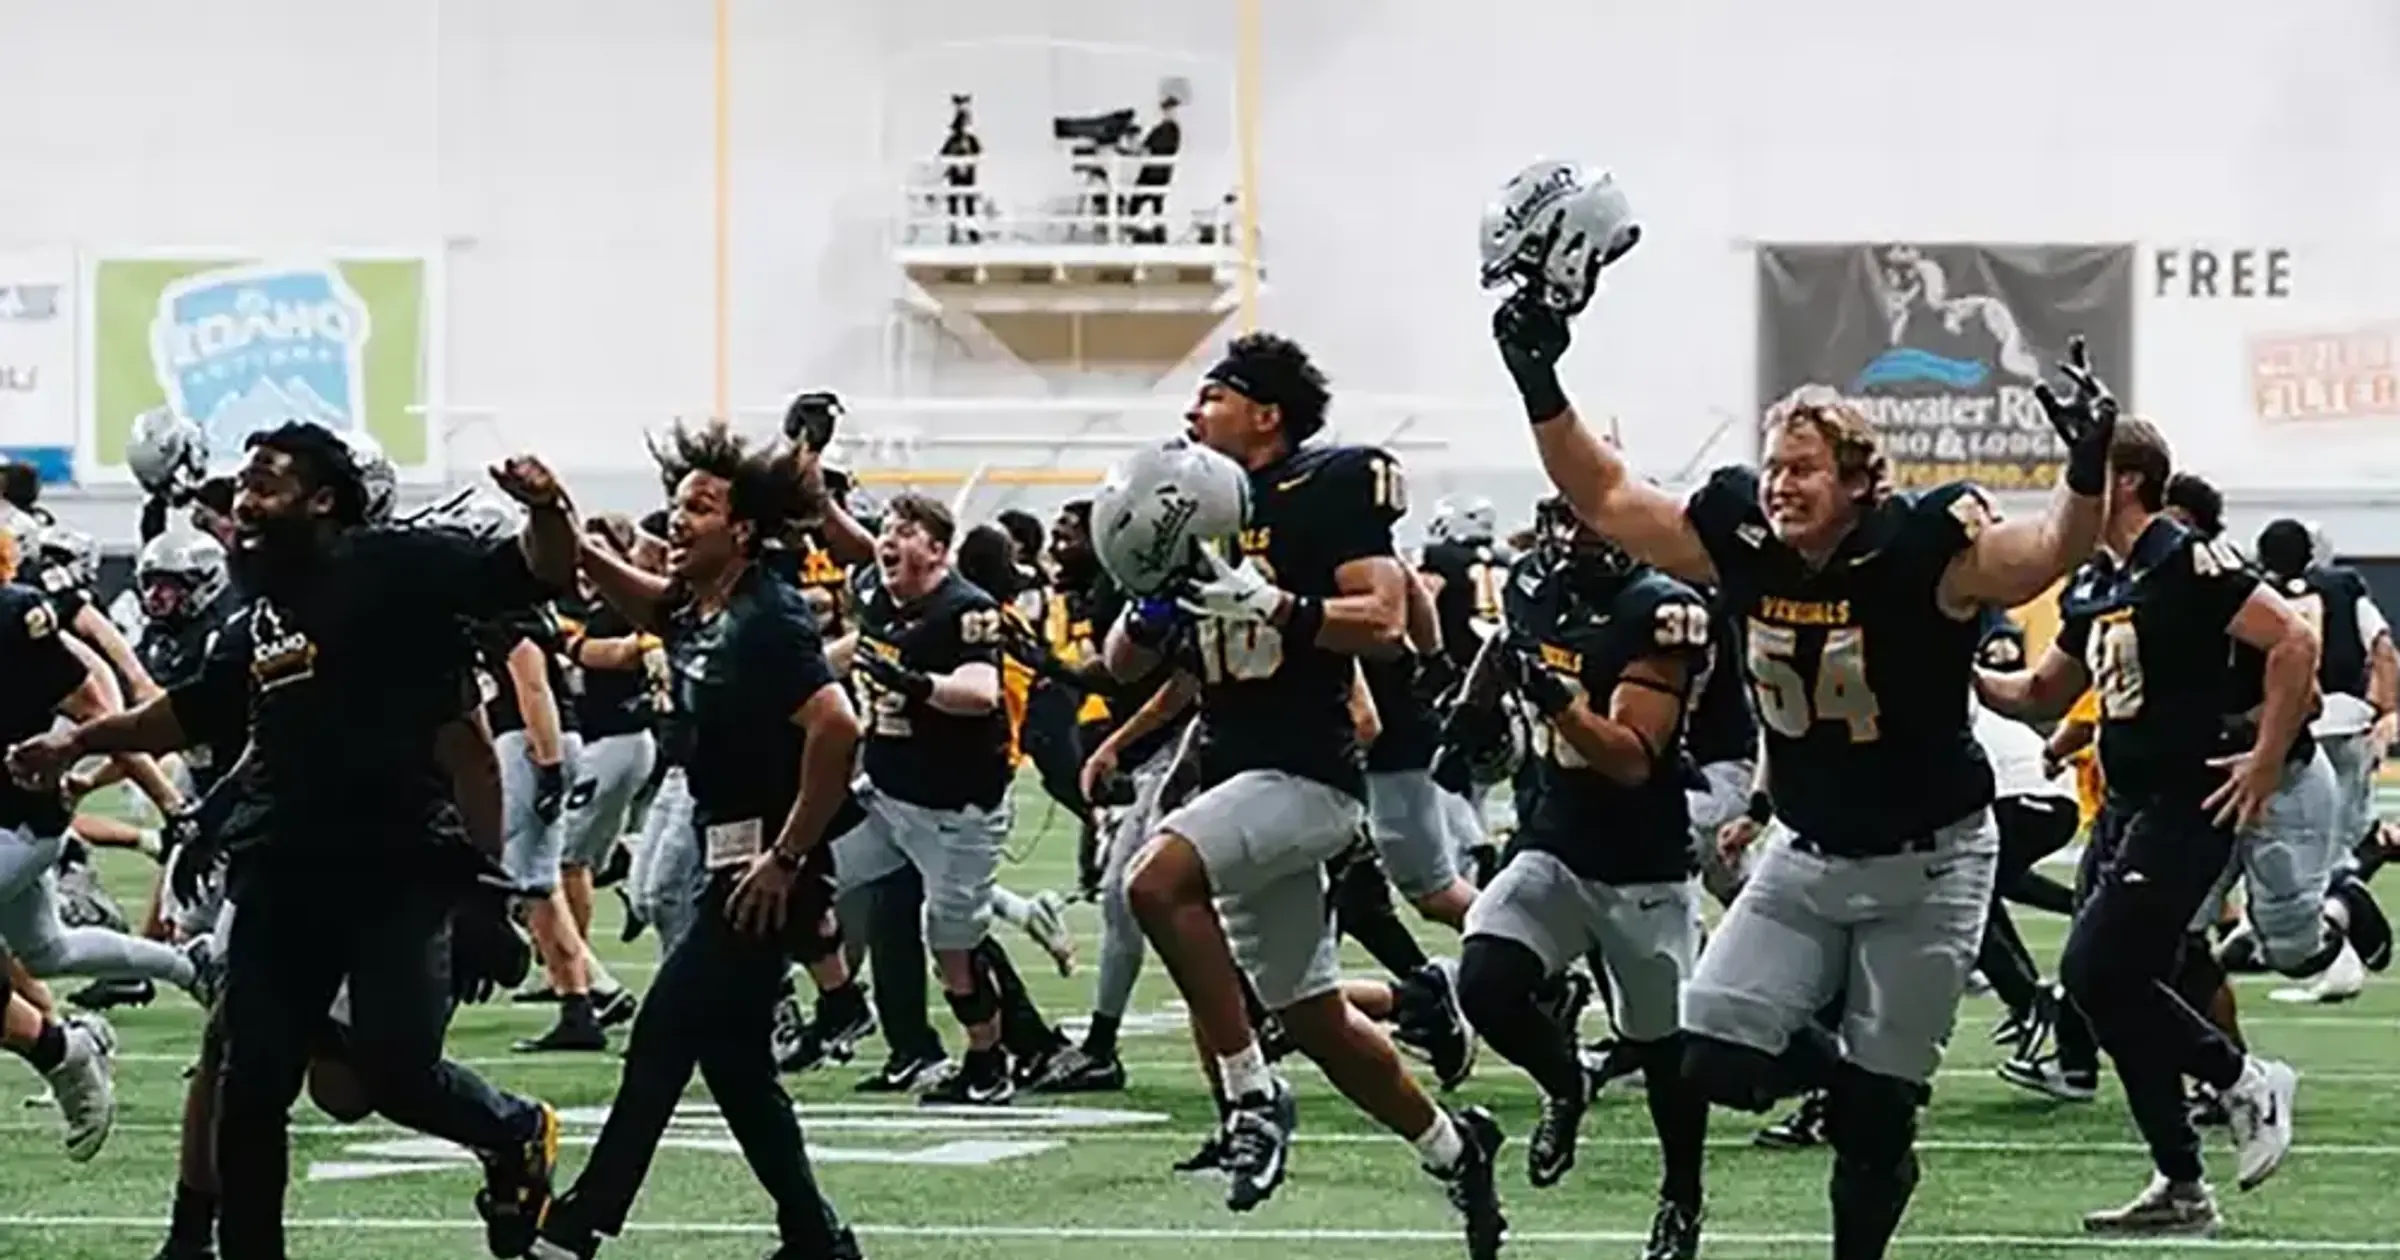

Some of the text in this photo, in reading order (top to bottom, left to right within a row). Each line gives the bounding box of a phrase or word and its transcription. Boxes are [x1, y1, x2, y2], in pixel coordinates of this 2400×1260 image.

[2154, 248, 2291, 298] FREE
[1197, 615, 1284, 685] 10
[1654, 602, 1710, 646] 30
[1747, 614, 1880, 743] 54
